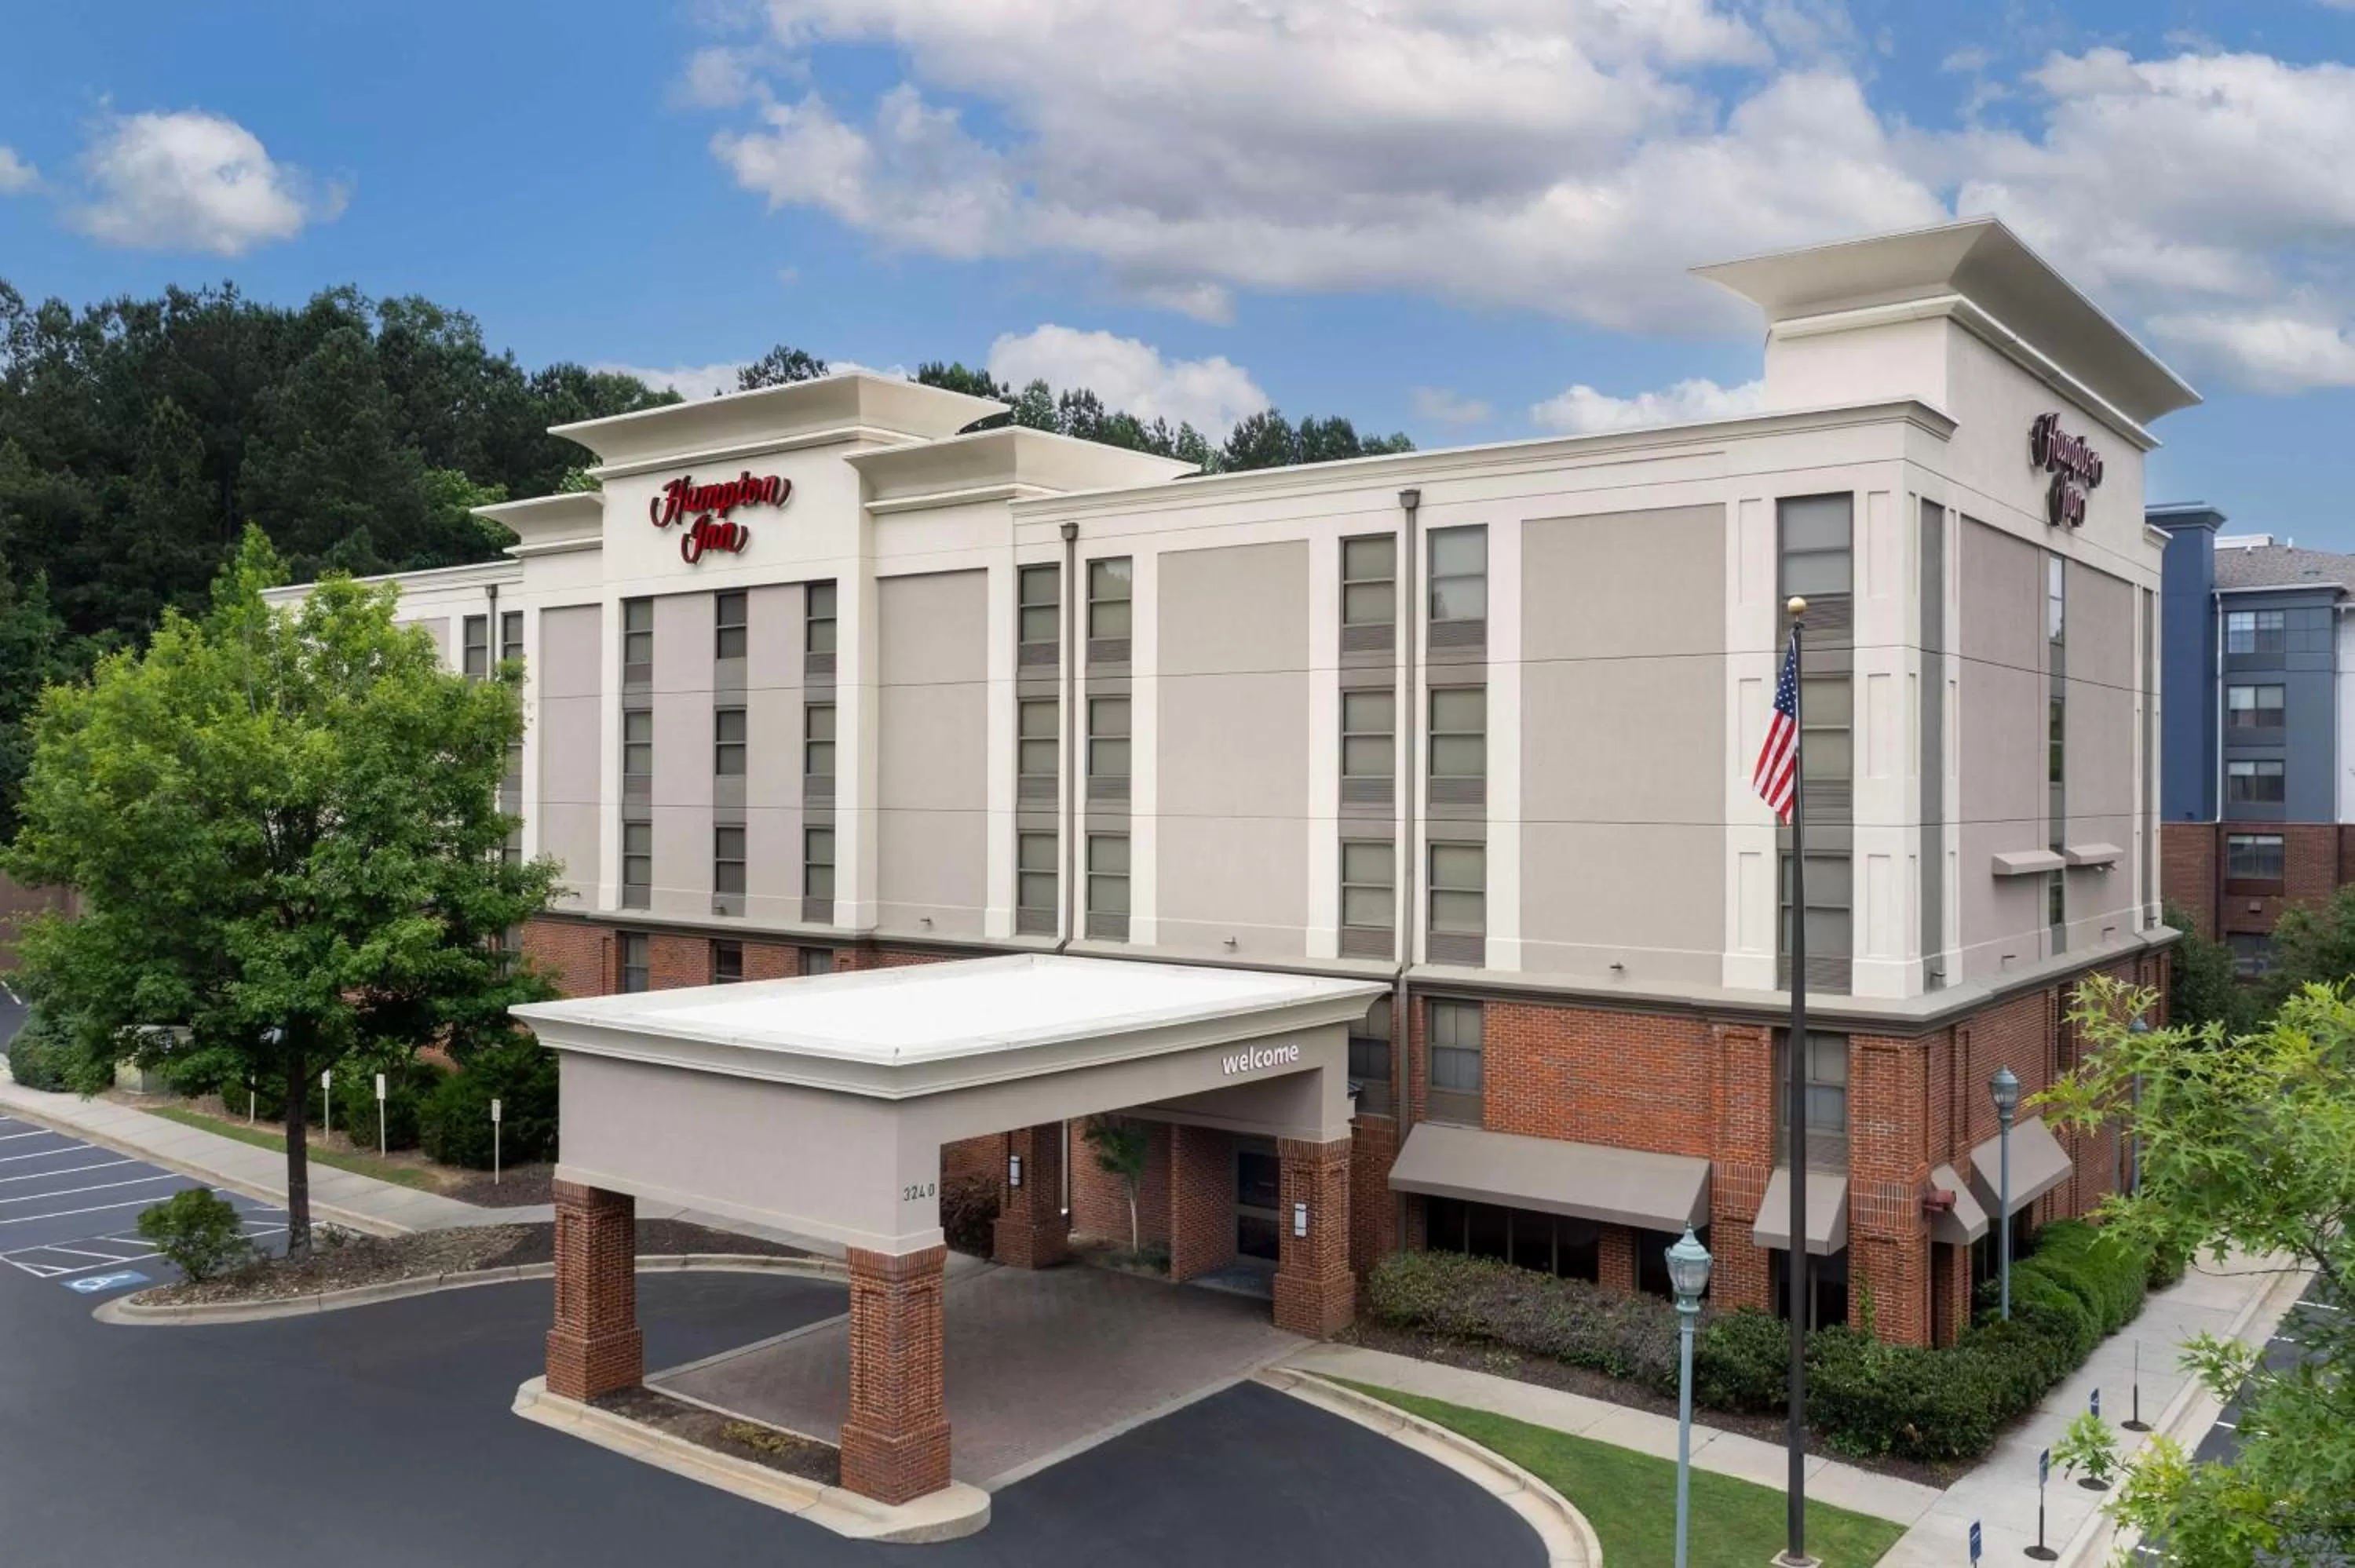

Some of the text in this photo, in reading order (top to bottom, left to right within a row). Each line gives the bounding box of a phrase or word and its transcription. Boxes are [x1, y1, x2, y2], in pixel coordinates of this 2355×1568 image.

[2029, 412, 2104, 488] Hampton
[650, 471, 792, 527] Hampton
[2048, 471, 2086, 528] Inn
[681, 514, 749, 564] Inn
[1221, 1045, 1299, 1075] welcome
[904, 1183, 935, 1202] 3240
